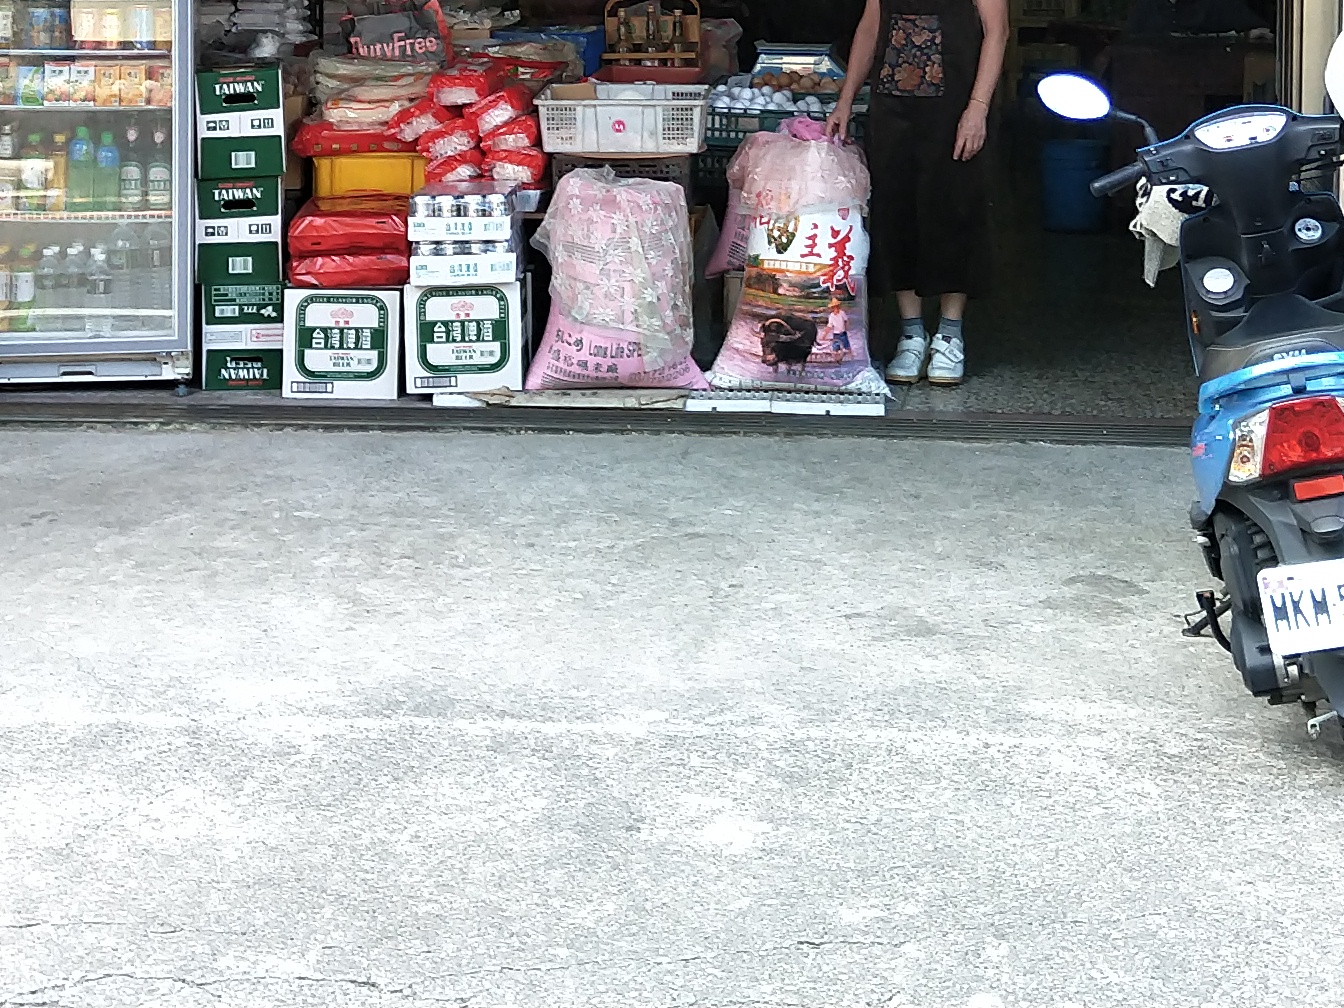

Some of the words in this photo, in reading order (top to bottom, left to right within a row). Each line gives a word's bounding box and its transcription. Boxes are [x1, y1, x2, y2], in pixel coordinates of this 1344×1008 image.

[213, 80, 264, 95] TAIWAN
[212, 187, 263, 201] TAIWAN
[311, 328, 372, 349] 台灣啤酒
[432, 319, 494, 343] 台灣啤酒
[218, 368, 270, 380] TAIWAN
